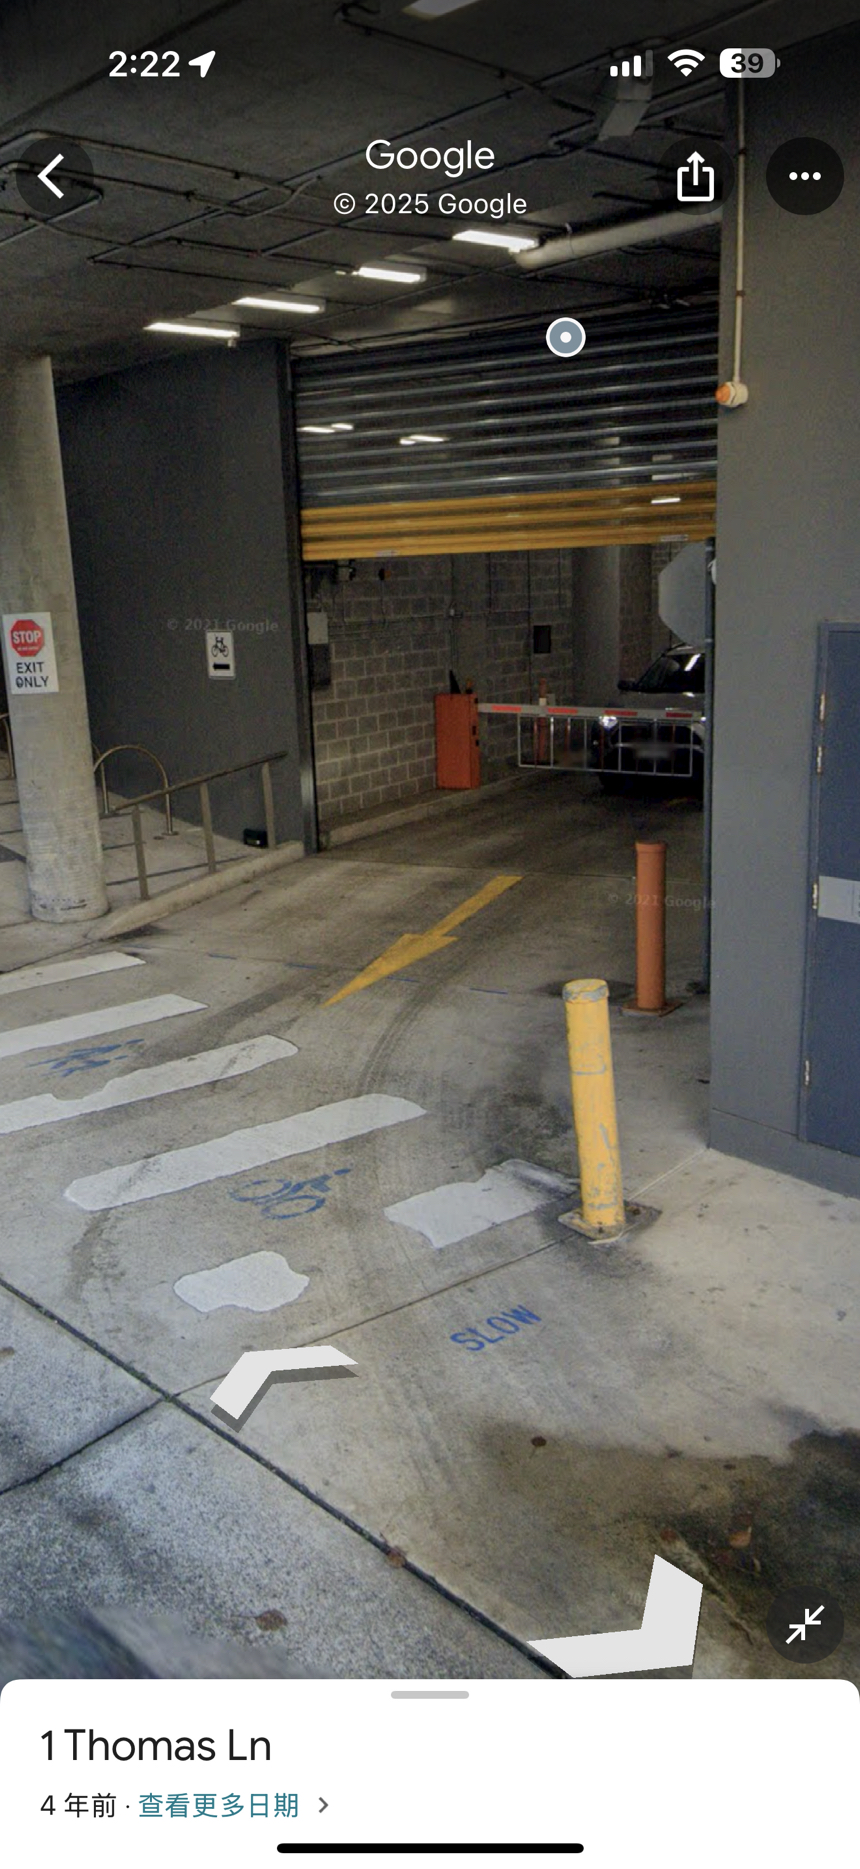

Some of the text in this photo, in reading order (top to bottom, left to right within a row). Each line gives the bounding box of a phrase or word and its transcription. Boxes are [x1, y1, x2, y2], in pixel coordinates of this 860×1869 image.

[12, 630, 41, 645] STOP
[16, 661, 44, 674] EXIT
[15, 676, 49, 689] ONLY
[450, 1304, 542, 1351] SLOW
